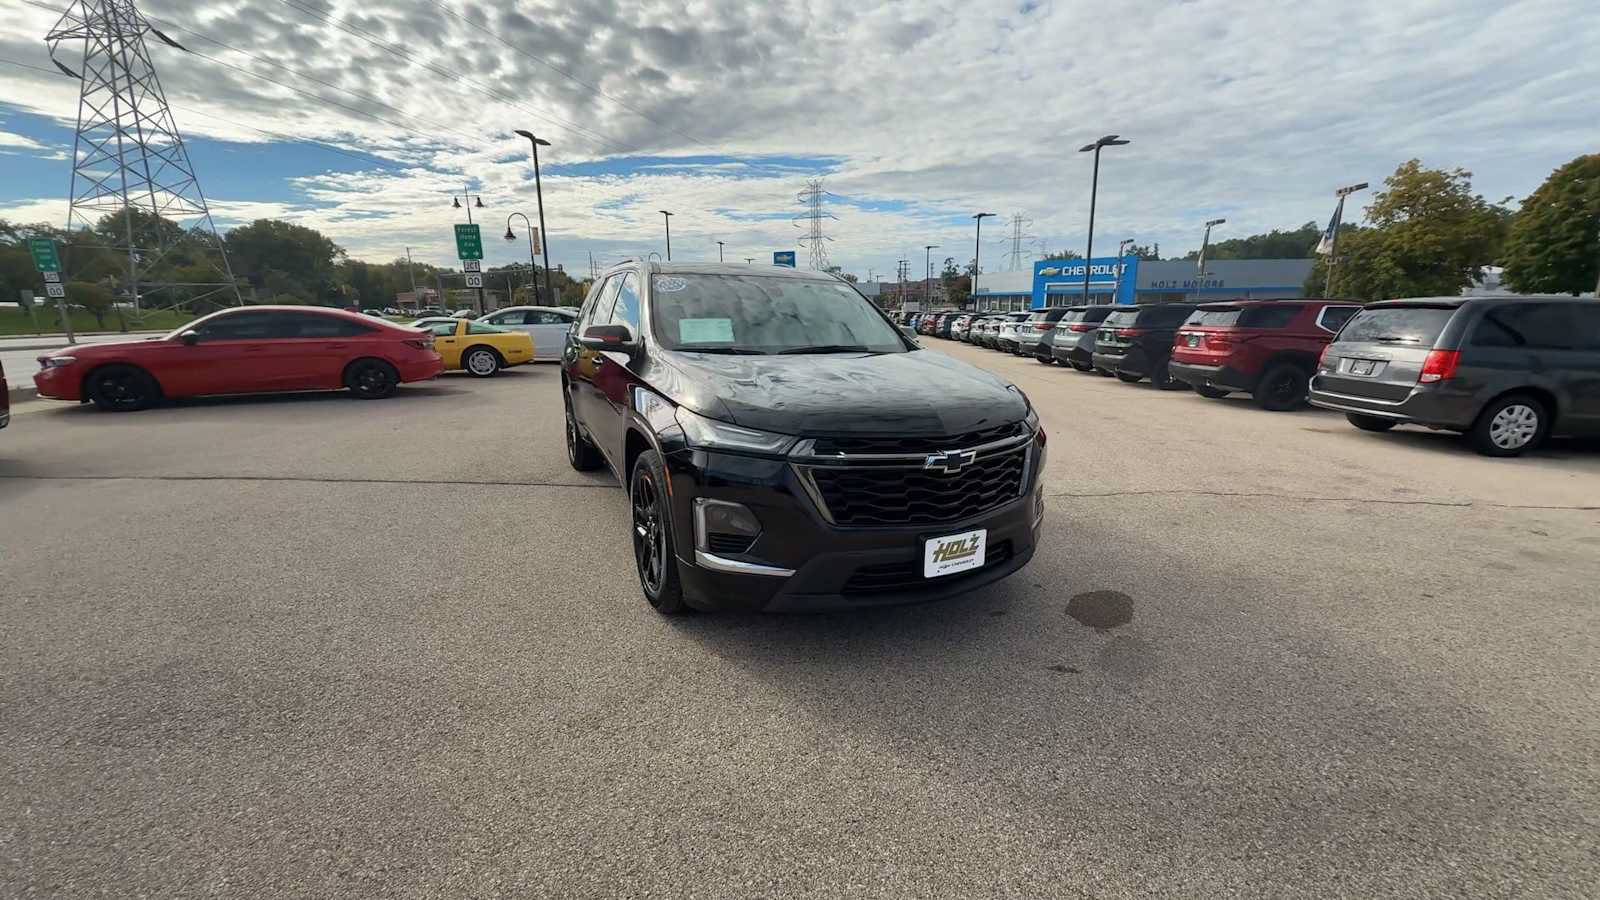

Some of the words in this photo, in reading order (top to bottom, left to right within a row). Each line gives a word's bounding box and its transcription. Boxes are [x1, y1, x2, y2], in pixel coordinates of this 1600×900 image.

[1151, 280, 1177, 288] HOLZ
[1183, 279, 1225, 288] MOTORS
[932, 536, 980, 563] HOLZ
